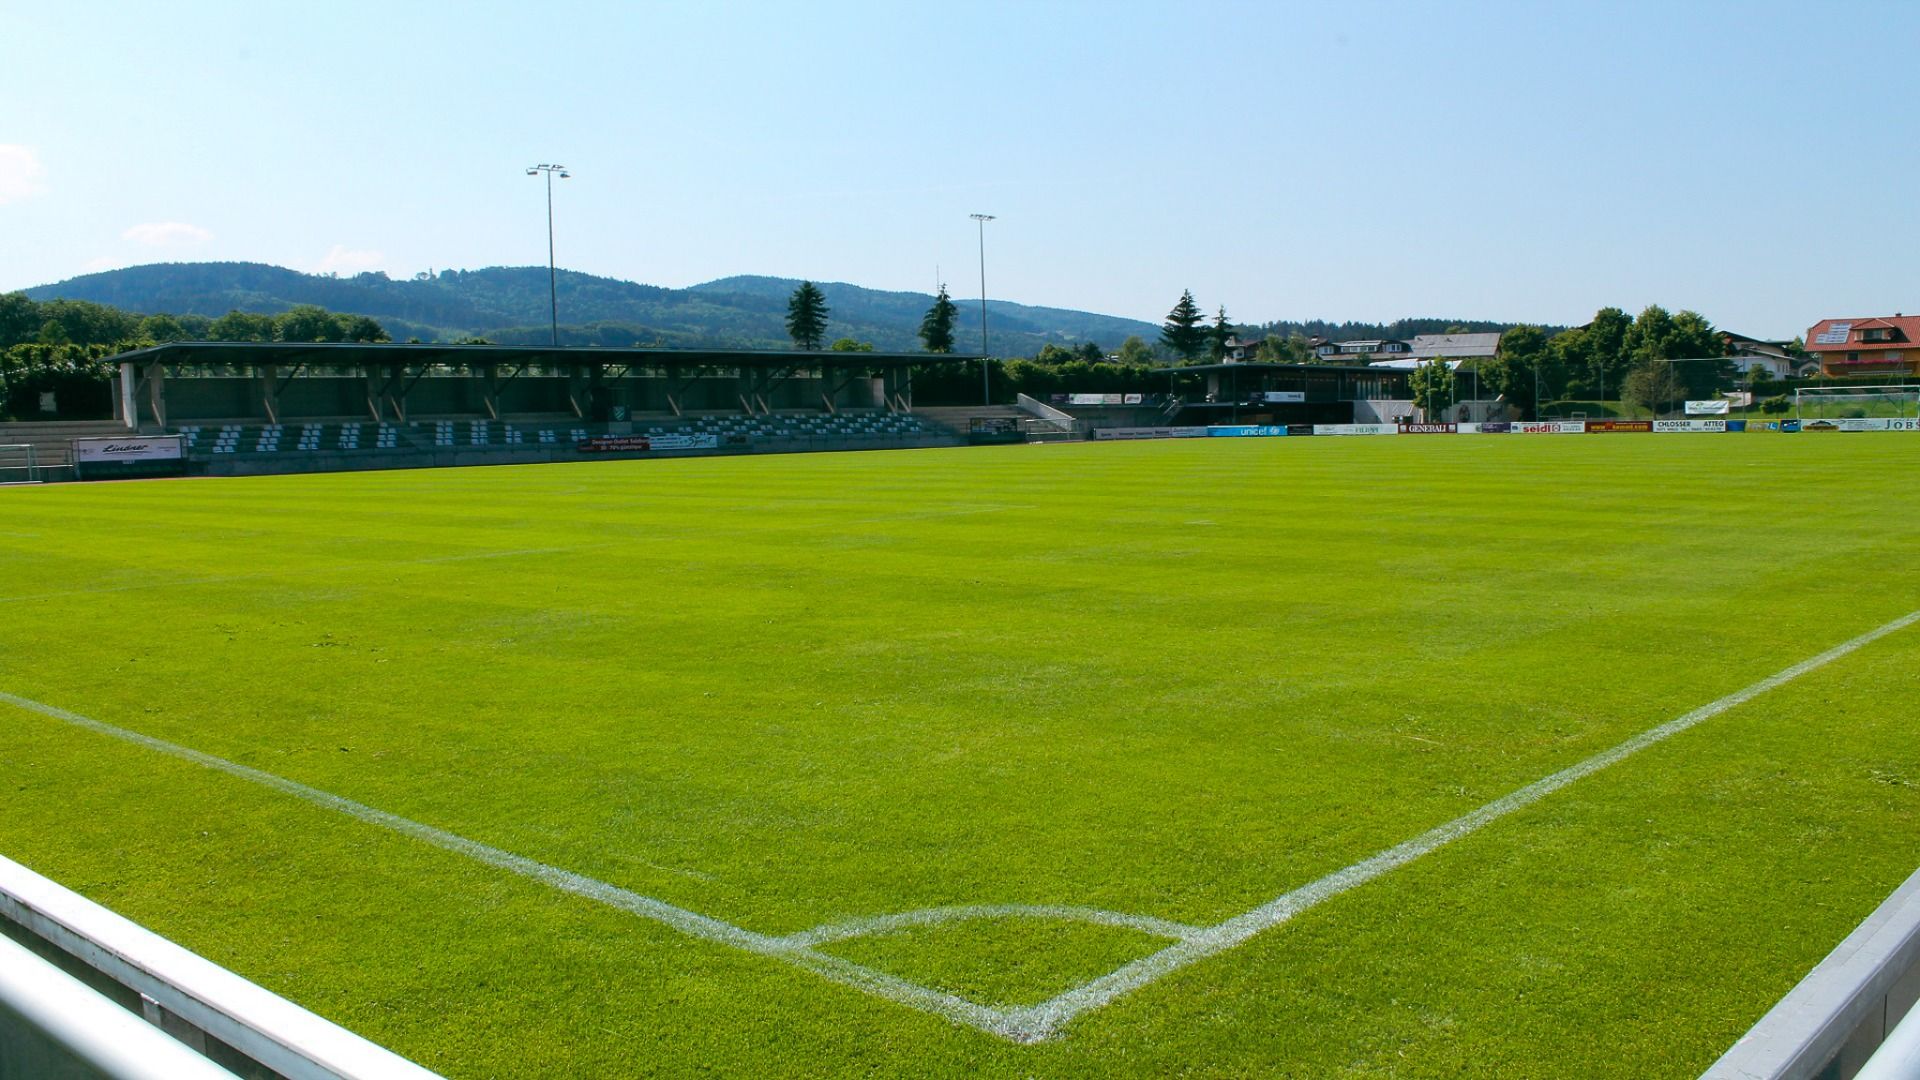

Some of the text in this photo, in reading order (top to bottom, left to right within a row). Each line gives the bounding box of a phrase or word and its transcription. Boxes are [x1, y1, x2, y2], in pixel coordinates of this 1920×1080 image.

[1240, 425, 1267, 436] unicef
[1408, 424, 1447, 433] GENERALI
[1522, 423, 1551, 433] seidl
[102, 444, 149, 453] Lindner
